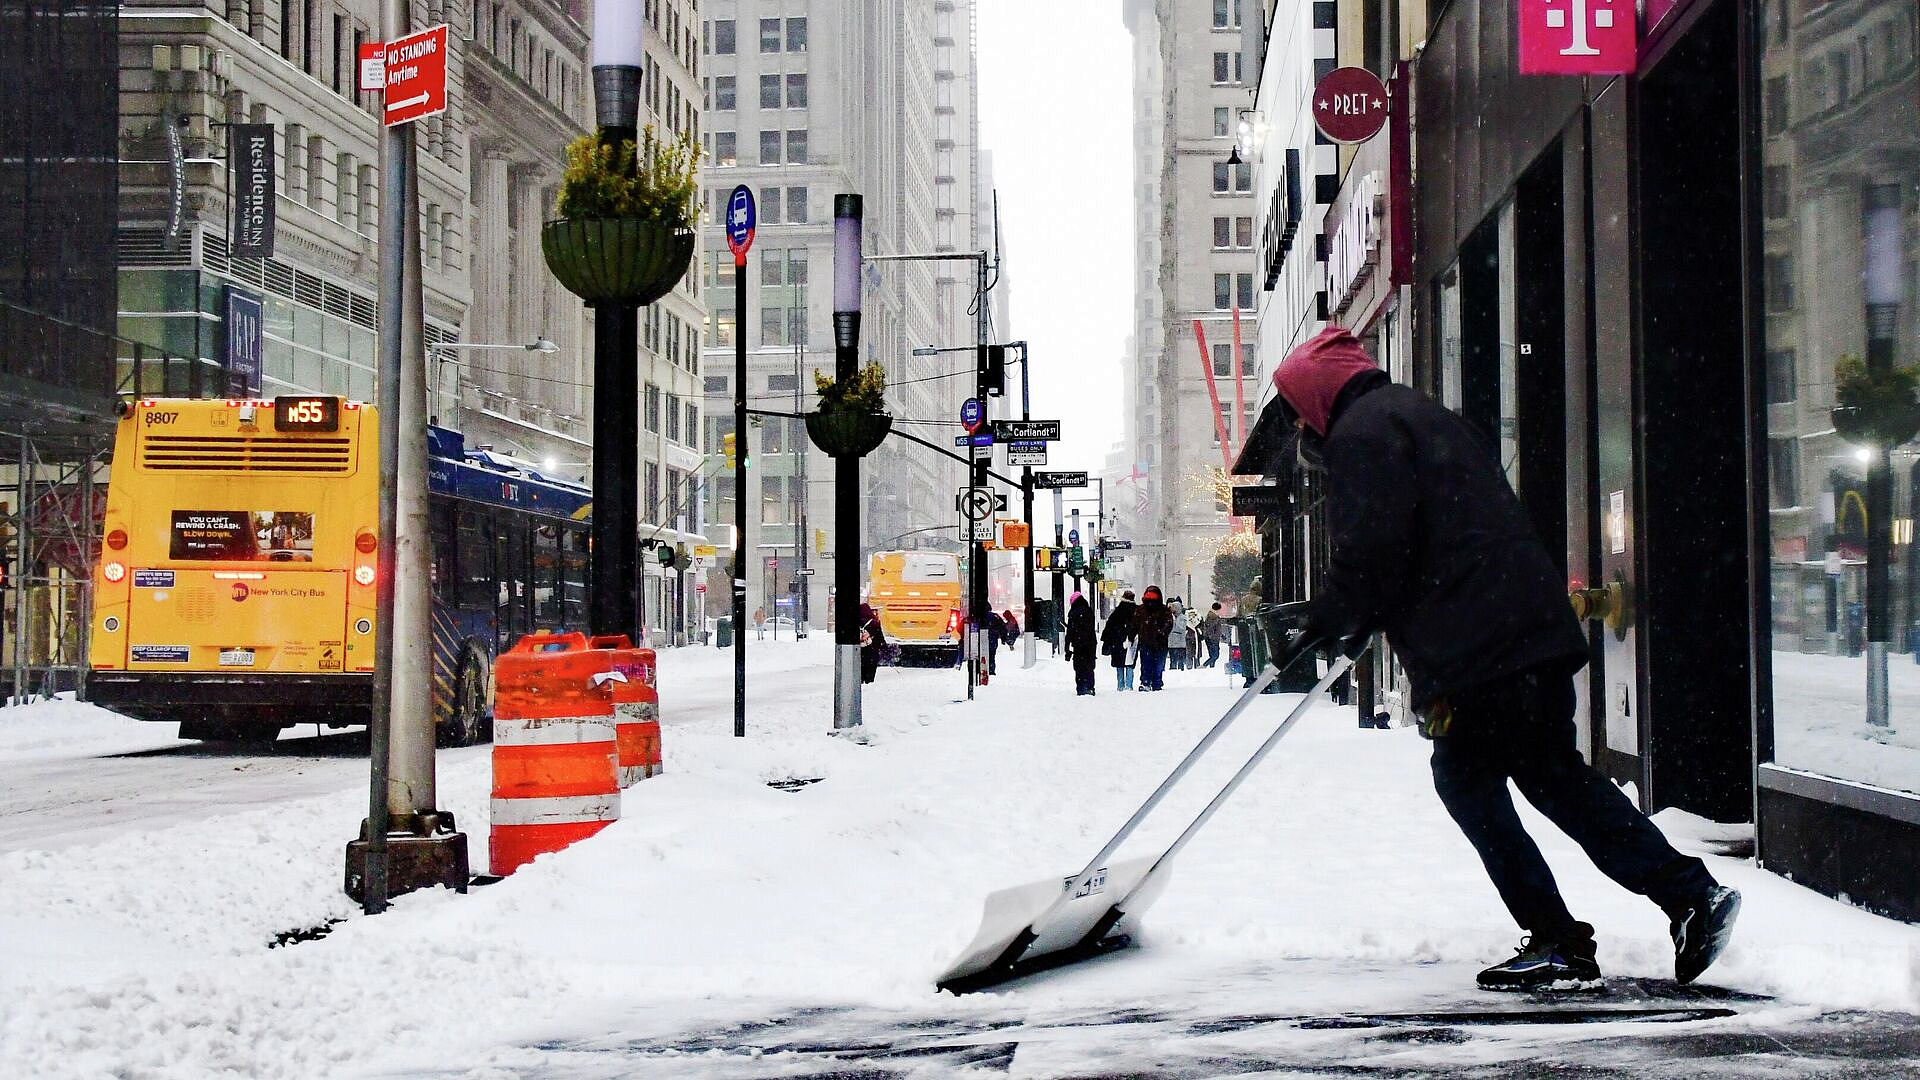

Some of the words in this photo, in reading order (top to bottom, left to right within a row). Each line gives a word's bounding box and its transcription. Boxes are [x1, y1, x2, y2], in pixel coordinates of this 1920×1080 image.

[388, 50, 398, 66] NO
[400, 37, 437, 62] STANDING
[388, 65, 418, 86] Anytime
[1334, 93, 1368, 115] PRET
[251, 137, 267, 224] Residence
[249, 227, 263, 246] INN
[236, 311, 255, 361] GAP
[145, 412, 179, 424] 8807
[288, 401, 323, 423] M55
[1014, 428, 1050, 437] Cortlandt
[1052, 477, 1080, 485] Cortlandt
[250, 588, 268, 596] New
[270, 588, 288, 596] York
[290, 589, 308, 597] City
[309, 589, 325, 597] Bus
